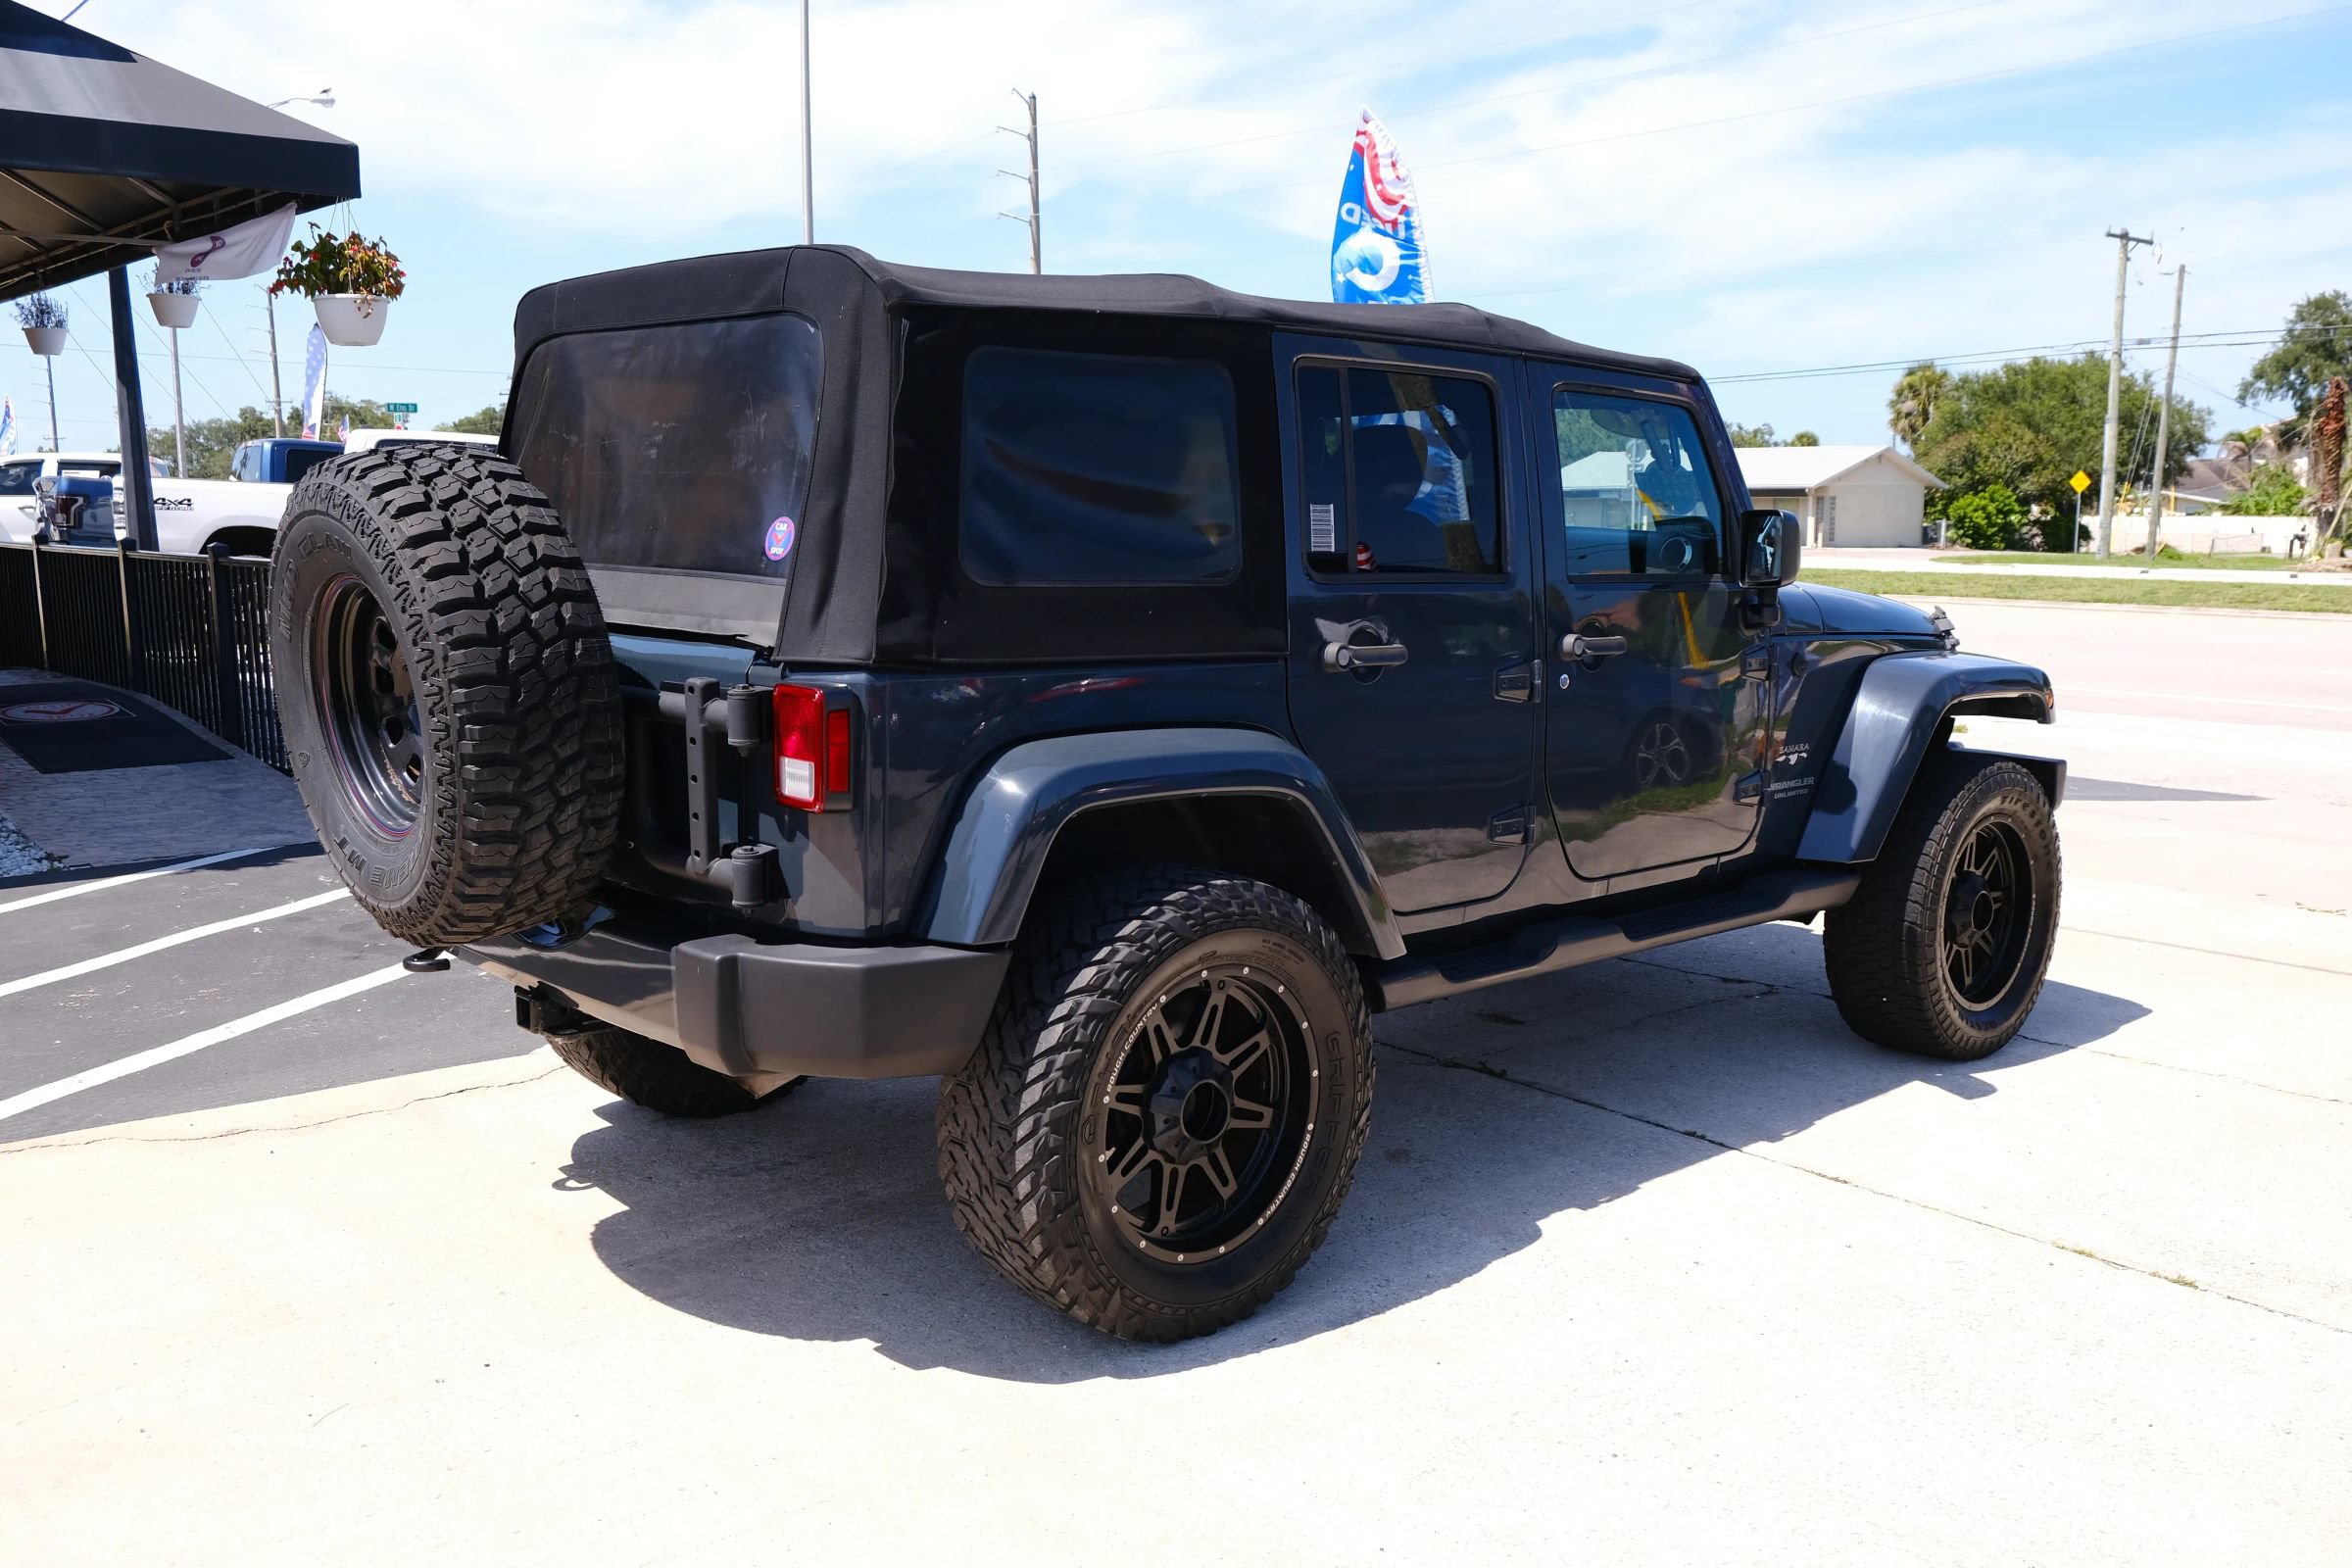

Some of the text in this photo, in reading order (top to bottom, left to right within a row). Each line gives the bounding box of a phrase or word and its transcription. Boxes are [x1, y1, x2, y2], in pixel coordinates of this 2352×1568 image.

[1779, 743, 1809, 754] SAHARA
[1770, 777, 1814, 791] WRANGLER
[1774, 789, 1808, 799] UNLIMITED
[1106, 1004, 1158, 1093] ROUGH COUNTRY
[1265, 1133, 1311, 1218] ROUGH COUNTRY
